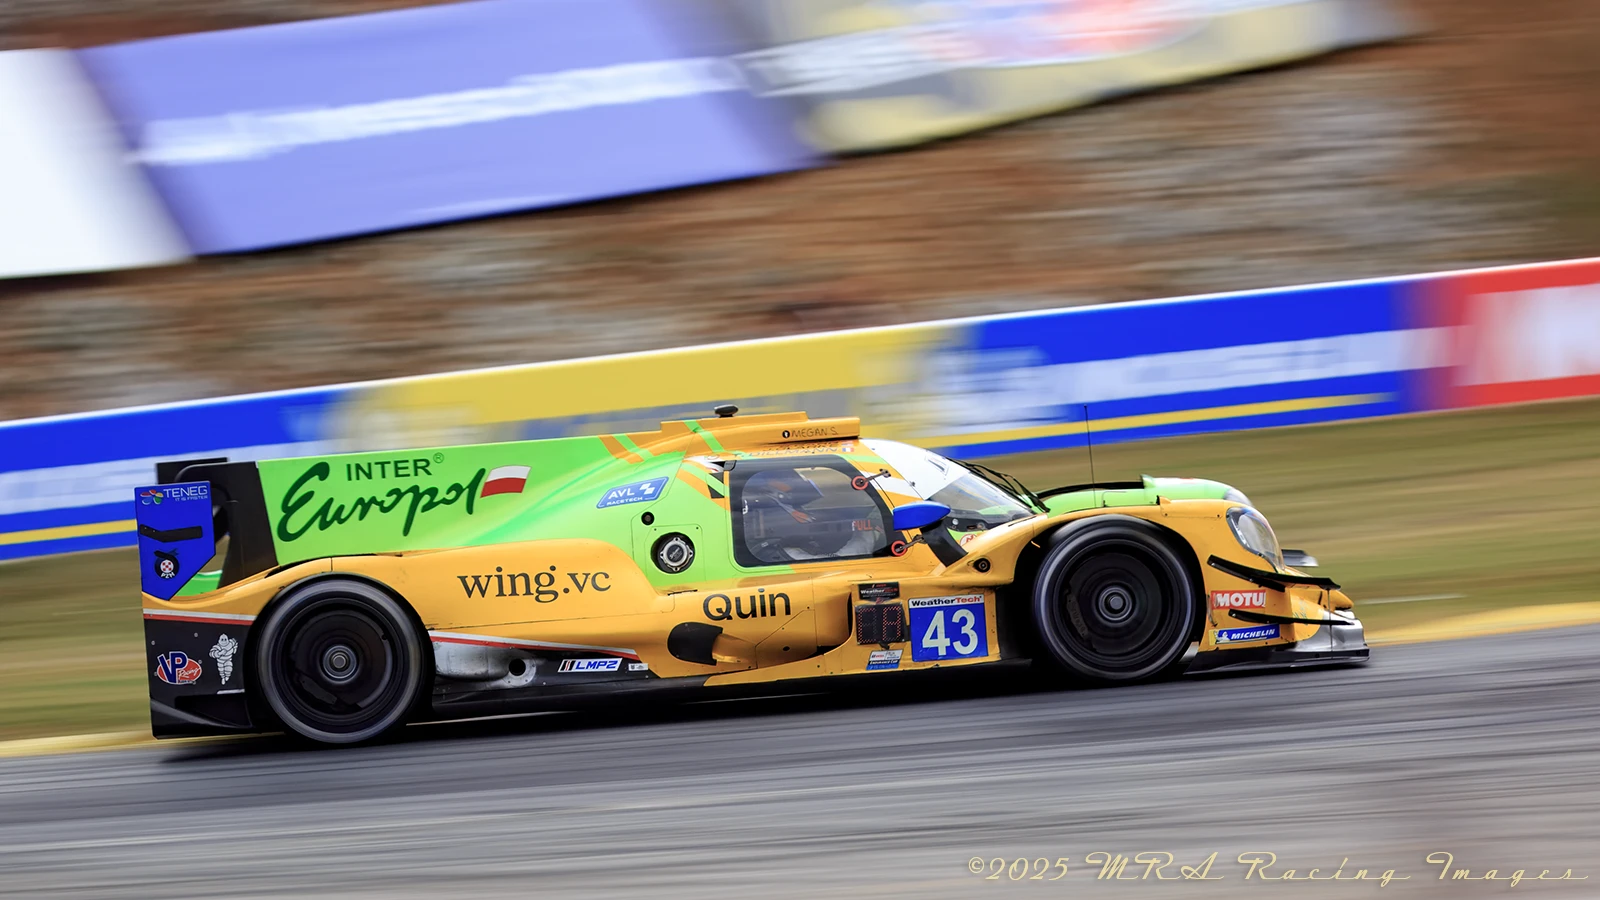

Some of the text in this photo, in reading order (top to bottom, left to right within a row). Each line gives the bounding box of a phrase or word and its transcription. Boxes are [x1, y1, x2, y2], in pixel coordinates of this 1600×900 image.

[791, 428, 828, 438] MEGAN
[163, 485, 208, 498] TENEG
[608, 487, 635, 500] AVL
[277, 461, 486, 542] Europol
[606, 496, 643, 506] RACETECH
[457, 565, 612, 603] wing.vc
[702, 588, 792, 622] Quin
[922, 609, 978, 656] 43
[1231, 629, 1276, 640] MICHELIN
[157, 651, 188, 684] VP
[575, 660, 618, 670] LMP2
